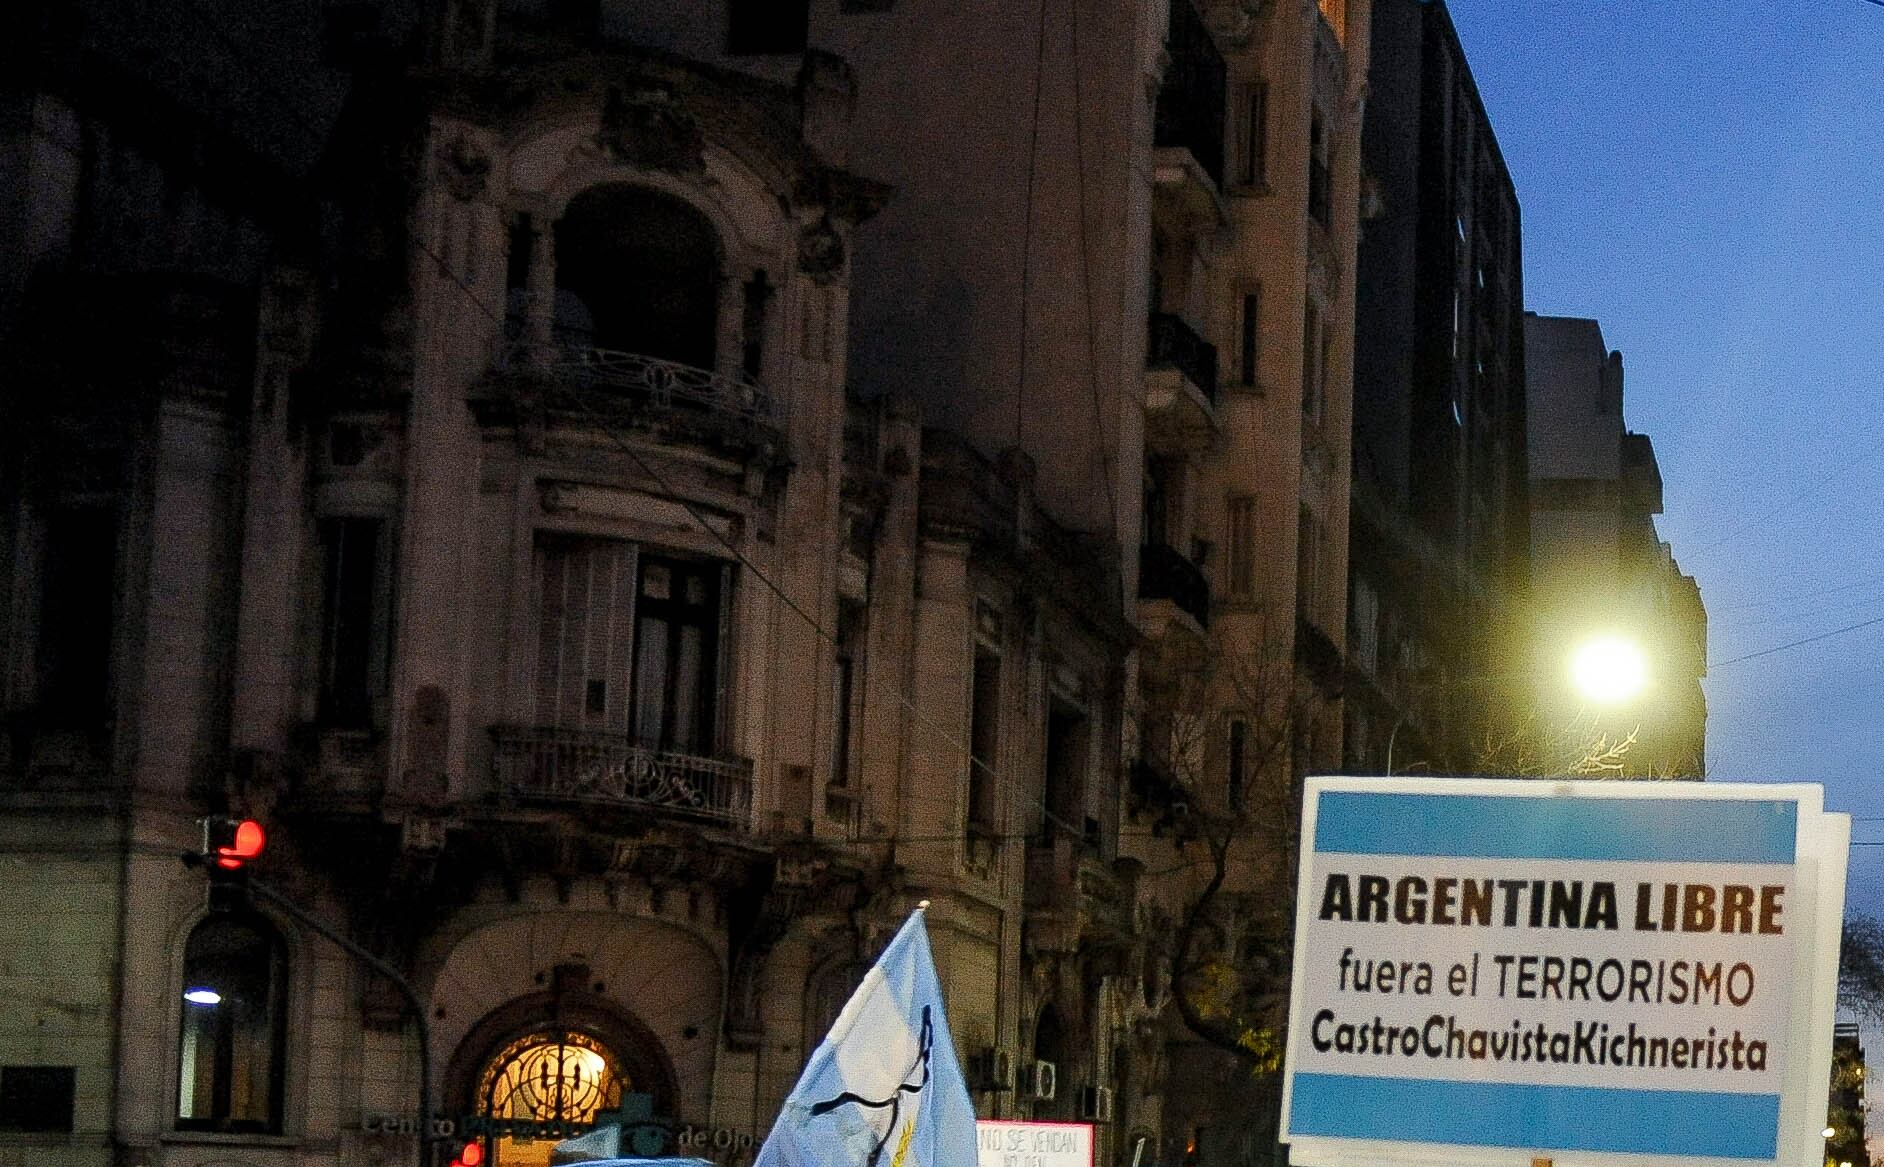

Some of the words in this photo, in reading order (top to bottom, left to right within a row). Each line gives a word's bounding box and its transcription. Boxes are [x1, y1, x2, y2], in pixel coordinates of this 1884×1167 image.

[1319, 873, 1618, 931] ARGENTINA
[1635, 882, 1786, 935] LIBRE
[1338, 947, 1433, 996] fuera
[1447, 953, 1479, 997] el
[1494, 955, 1755, 1009] TERRORISMO
[1310, 1009, 1768, 1071] CastroChavistaKichnerista
